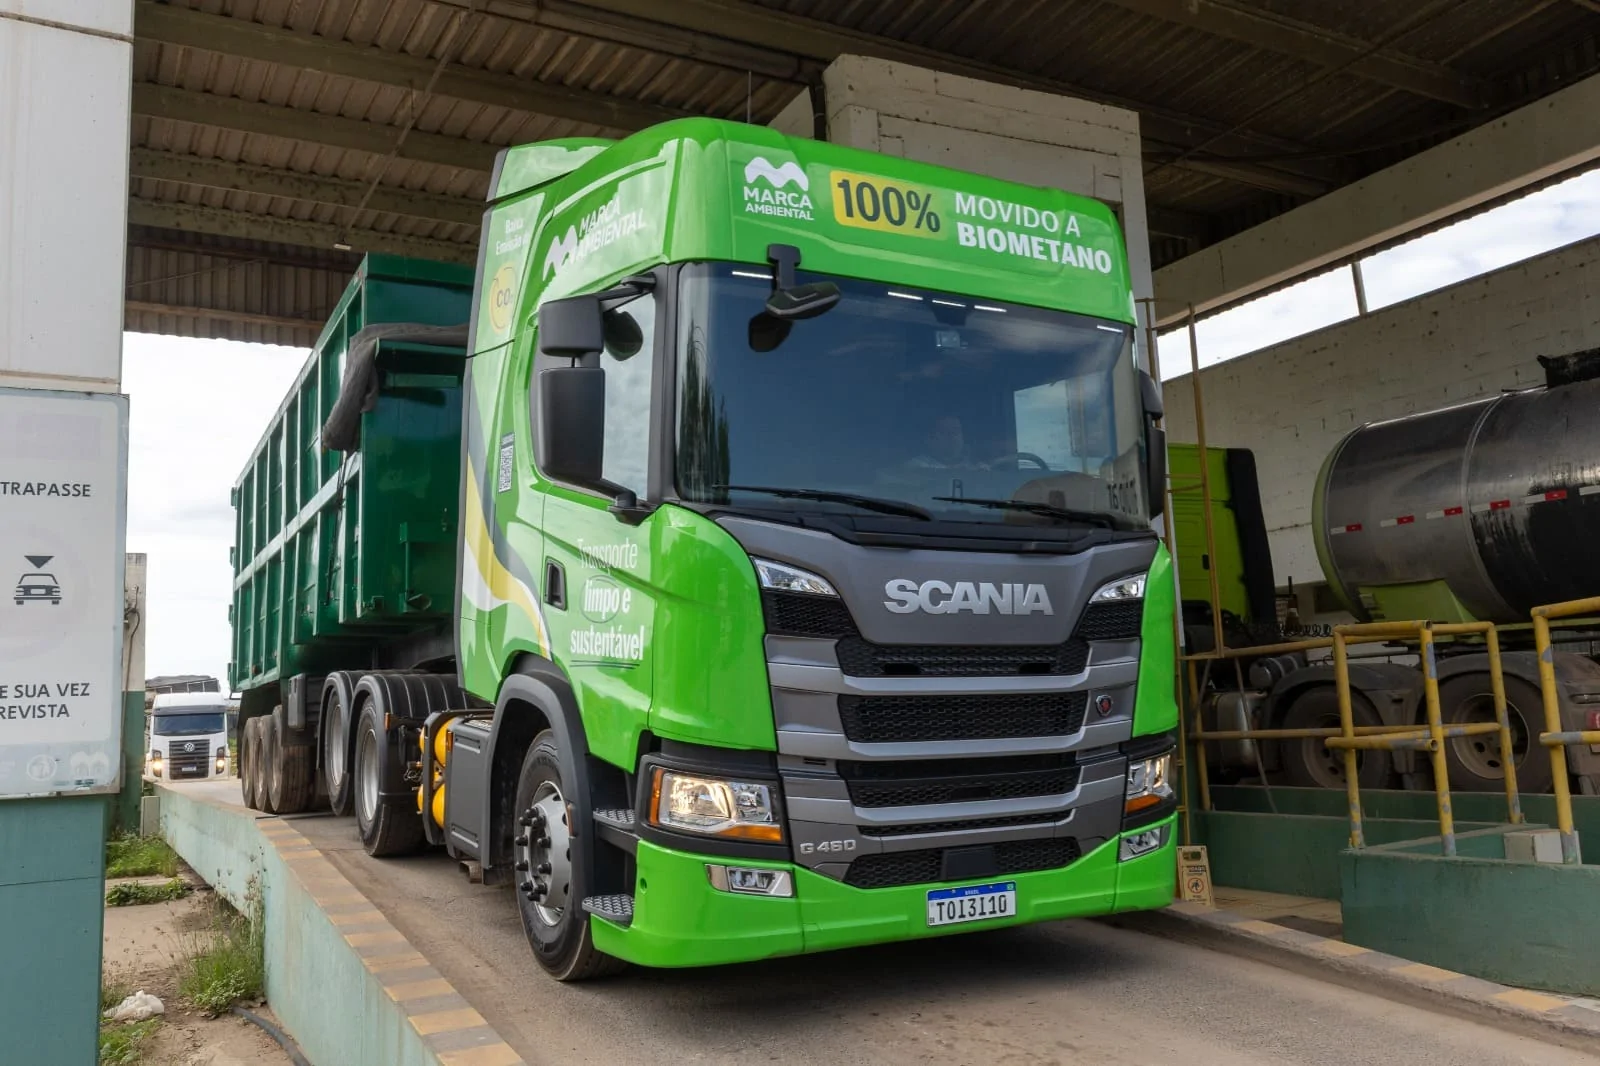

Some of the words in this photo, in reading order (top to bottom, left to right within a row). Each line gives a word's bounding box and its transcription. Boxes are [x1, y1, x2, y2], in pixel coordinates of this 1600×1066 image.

[579, 194, 621, 238] MARCA
[743, 186, 814, 209] MARCA
[745, 202, 815, 221] AMBIENTAL
[837, 178, 941, 234] 100%
[955, 191, 1058, 233] MOVIDO
[1065, 214, 1081, 238] A
[577, 207, 647, 258] AMBIENTAL
[957, 221, 1112, 274] BIOMETANO
[0, 481, 91, 498] TRAPASSE
[577, 537, 638, 577] Transporte
[583, 579, 620, 620] limpo
[622, 587, 631, 614] e
[883, 578, 1054, 616] SCANIA
[570, 625, 645, 661] sustentável
[13, 683, 50, 699] SUA
[56, 682, 90, 697] VEZ
[800, 842, 815, 855] G
[816, 839, 857, 853] 460
[936, 894, 1007, 922] TOI3I10
